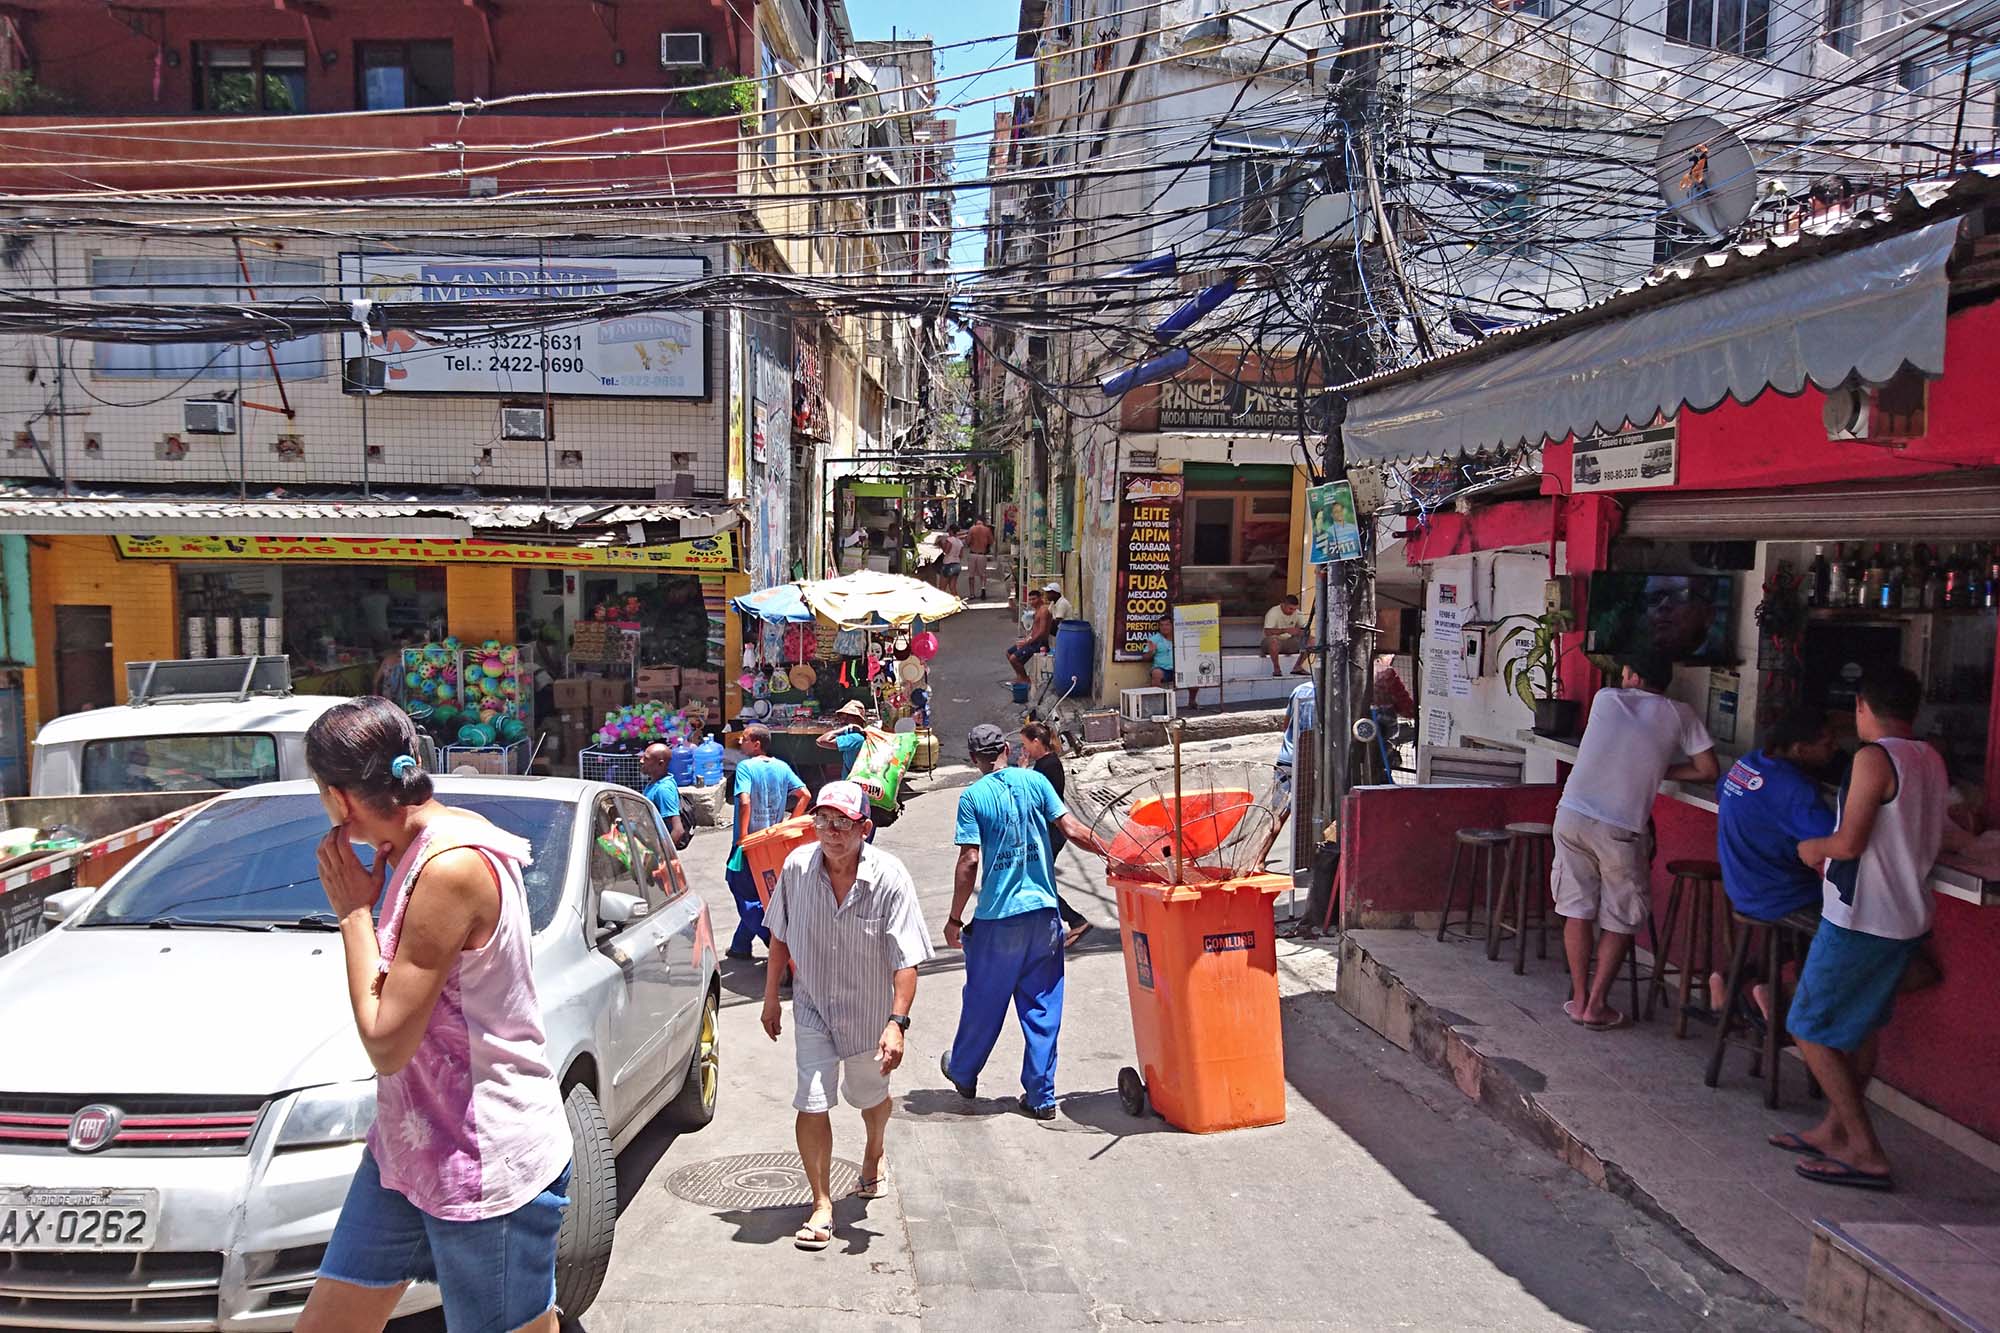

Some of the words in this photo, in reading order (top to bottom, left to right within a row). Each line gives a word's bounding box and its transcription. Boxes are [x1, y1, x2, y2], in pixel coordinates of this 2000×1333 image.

[488, 334, 583, 351] 3322-6631
[443, 356, 482, 372] Tel.:
[489, 356, 584, 373] 2422-0690
[600, 376, 619, 386] Tel.:
[1161, 383, 1231, 411] RANGEL
[1161, 411, 1186, 426] MODA
[1188, 413, 1229, 427] INFANTIL
[1133, 507, 1170, 521] LEITE
[1130, 528, 1170, 542] AIPIM
[258, 546, 337, 555] DAS
[352, 547, 594, 561] UTILIDADES
[1129, 542, 1171, 552] GOIABADA
[702, 556, 728, 564] 2,75
[1130, 552, 1170, 562] LARANJA
[1129, 563, 1170, 571] TRADICIONAL
[1128, 571, 1168, 590] FUBÁ
[1127, 591, 1167, 599] MESCLADO
[1126, 600, 1166, 613] COCO
[1126, 622, 1159, 631] PRESTIGI
[1204, 935, 1254, 950] COMLURB
[79, 1118, 106, 1139] FIAT
